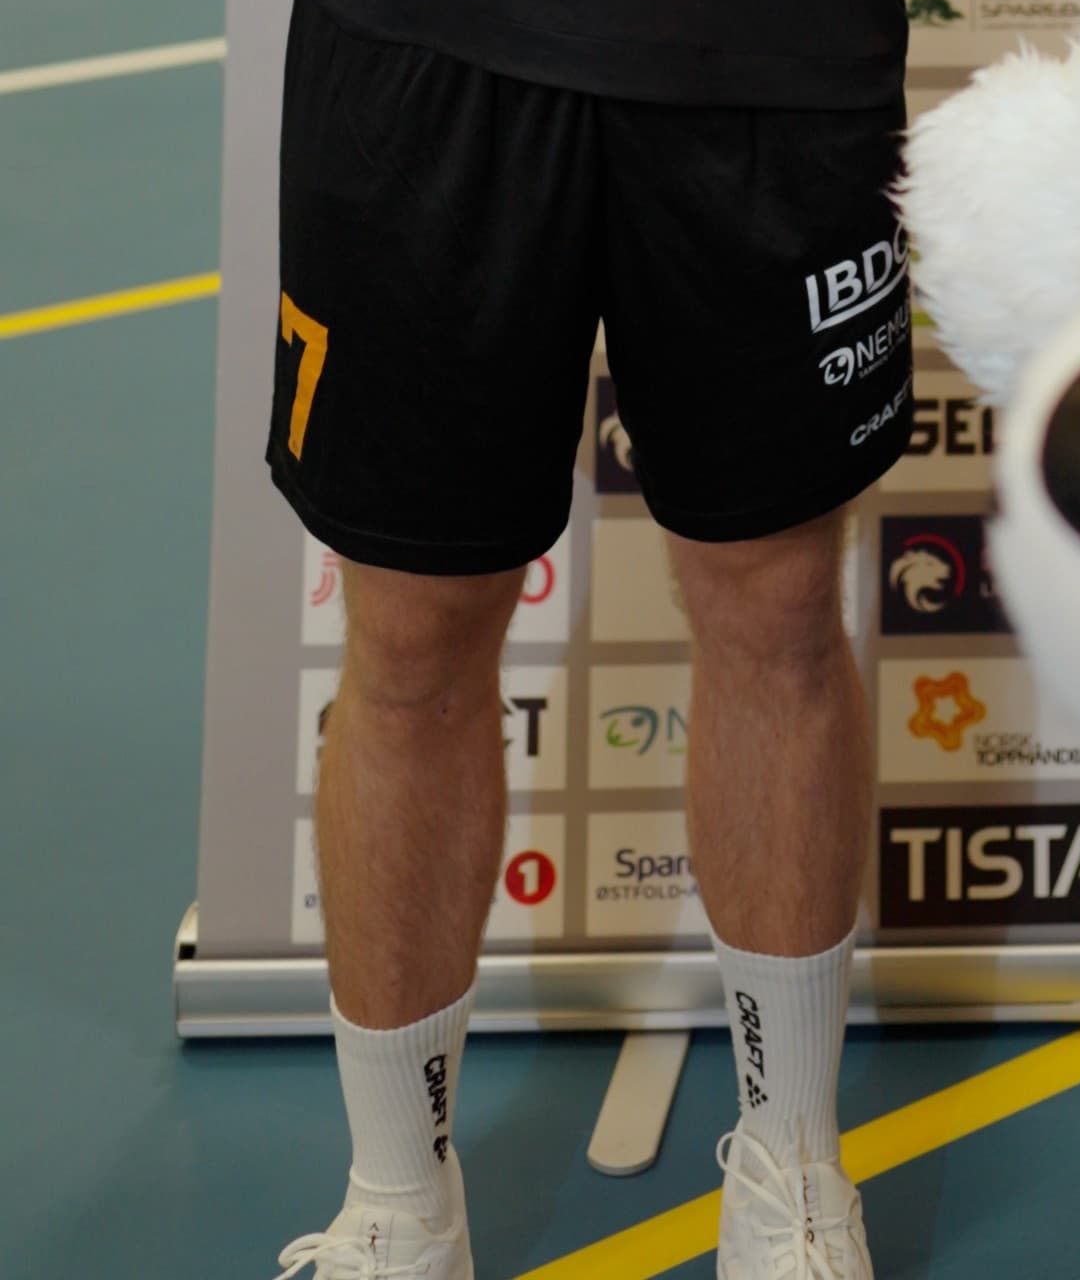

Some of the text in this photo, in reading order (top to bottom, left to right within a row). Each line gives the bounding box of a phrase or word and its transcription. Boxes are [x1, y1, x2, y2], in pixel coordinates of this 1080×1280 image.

[280, 290, 329, 462] 7
[735, 990, 766, 1078] CRAFT
[424, 1053, 448, 1127] CRAFT
